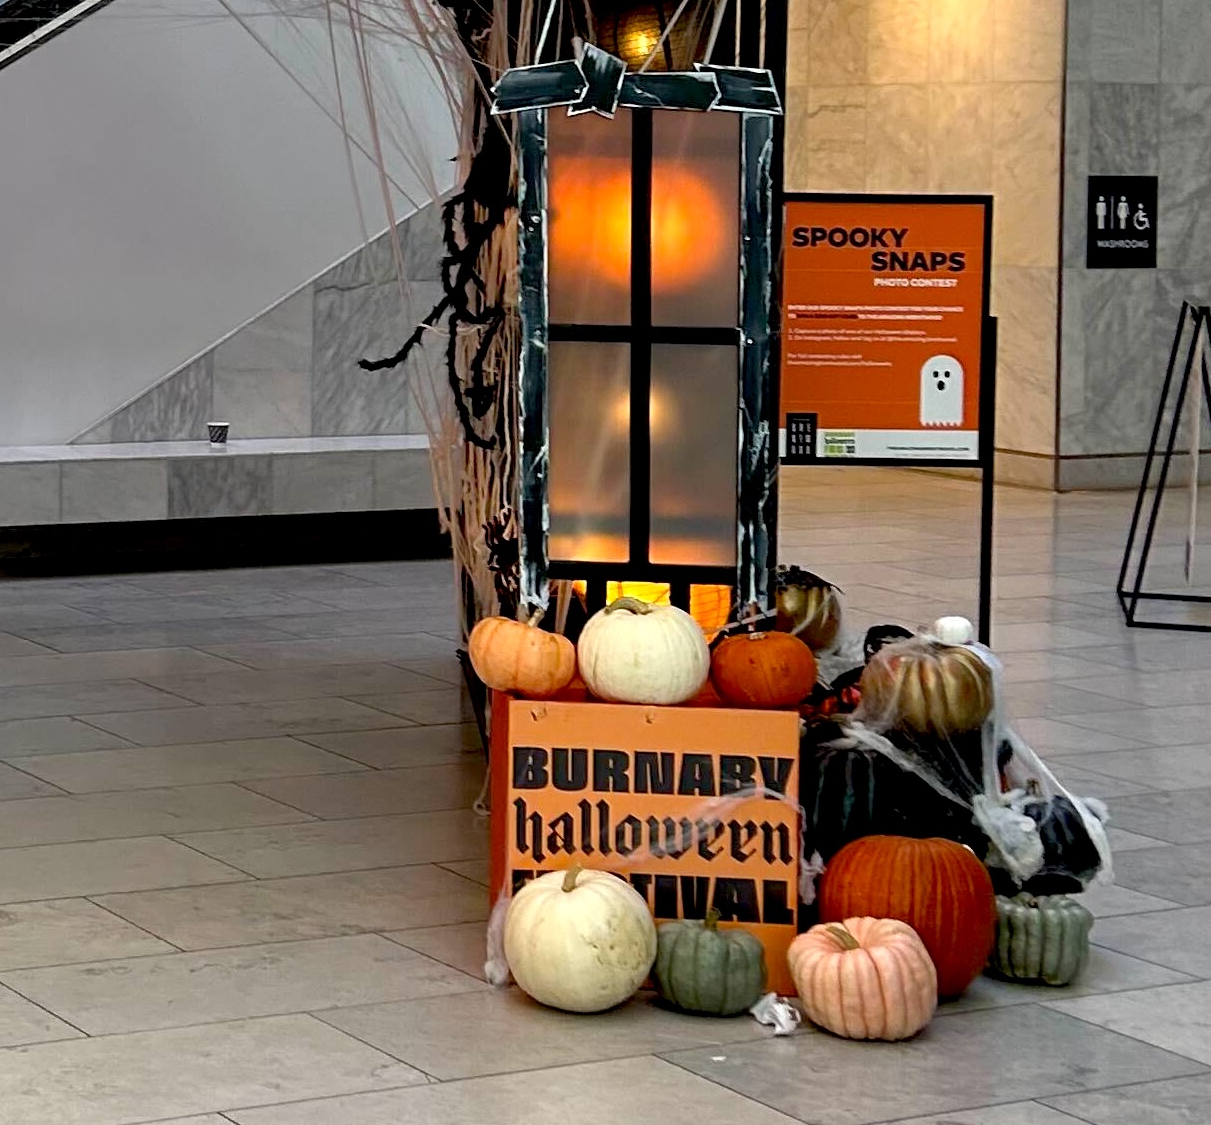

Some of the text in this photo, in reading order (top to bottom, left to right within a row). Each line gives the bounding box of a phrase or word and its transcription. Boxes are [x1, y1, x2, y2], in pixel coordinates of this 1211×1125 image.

[791, 227, 909, 248] SPOOKY
[870, 251, 966, 272] SNAPS
[873, 278, 958, 288] PHOTO CONTEST
[512, 746, 795, 800] BURNABY
[513, 796, 794, 866] halloween
[511, 869, 795, 925] TIVAL
